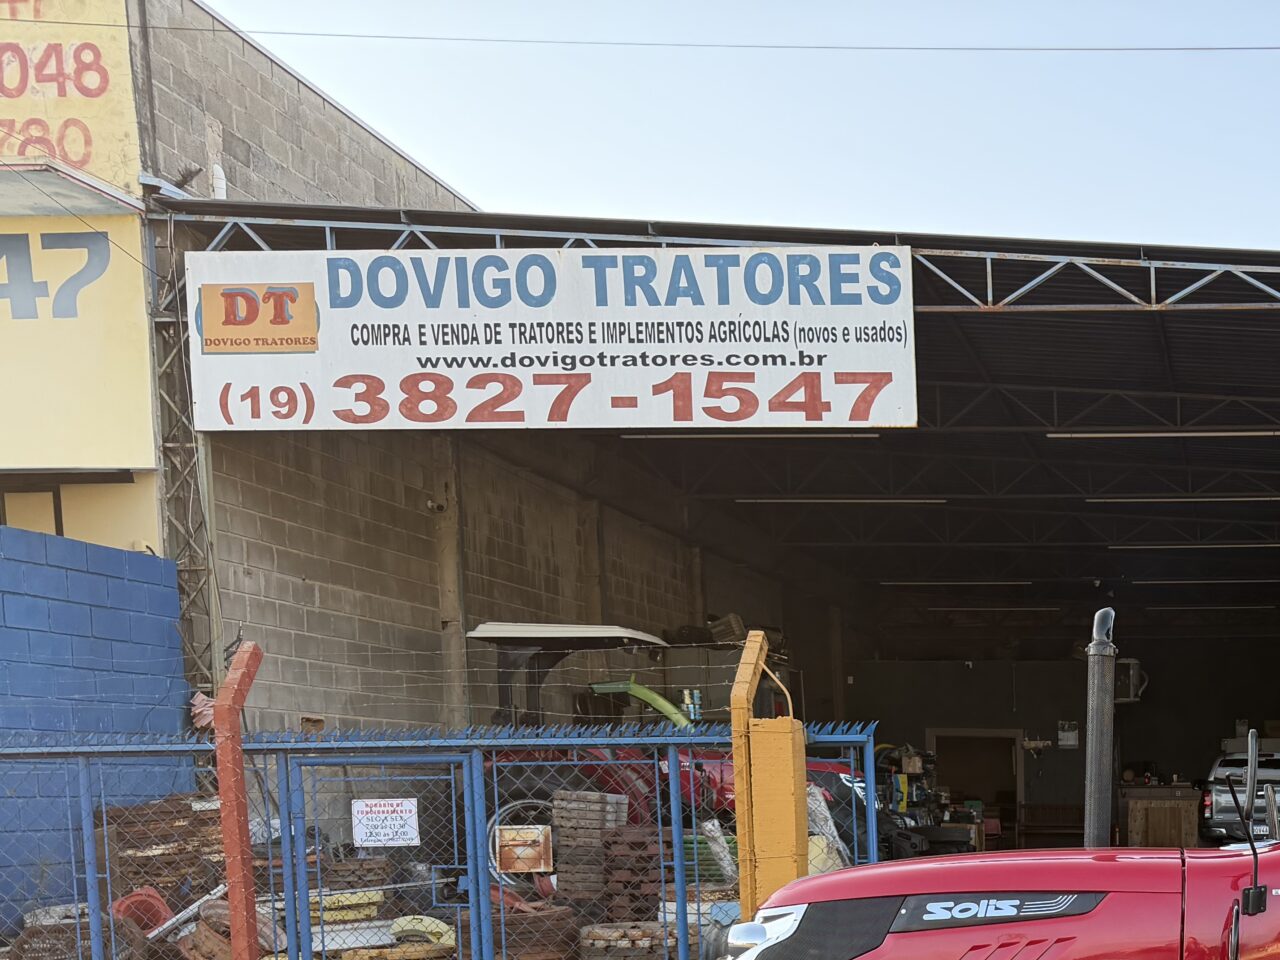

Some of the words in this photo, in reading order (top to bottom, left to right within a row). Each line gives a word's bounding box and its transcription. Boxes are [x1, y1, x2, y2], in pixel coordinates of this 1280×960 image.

[0, 231, 111, 319] 47
[326, 253, 557, 309] DOVIGO
[582, 251, 902, 307] TRATORES
[220, 286, 299, 326] DT
[204, 337, 251, 347] DOVIGO
[253, 336, 317, 347] TRATORES
[350, 323, 412, 346] COMPRA
[418, 323, 428, 346] E
[431, 323, 480, 346] VENDA
[484, 323, 501, 345] DE
[509, 321, 583, 345] TRATORES
[588, 321, 597, 344] E
[601, 320, 704, 344] IMPLEMENTOS
[708, 313, 790, 343] AGRÍCOLAS
[793, 320, 837, 349] (novos
[842, 327, 850, 343] e
[854, 319, 907, 349] usados)
[416, 350, 828, 372] www.dovigotratores.com.br
[219, 382, 316, 425] (19)
